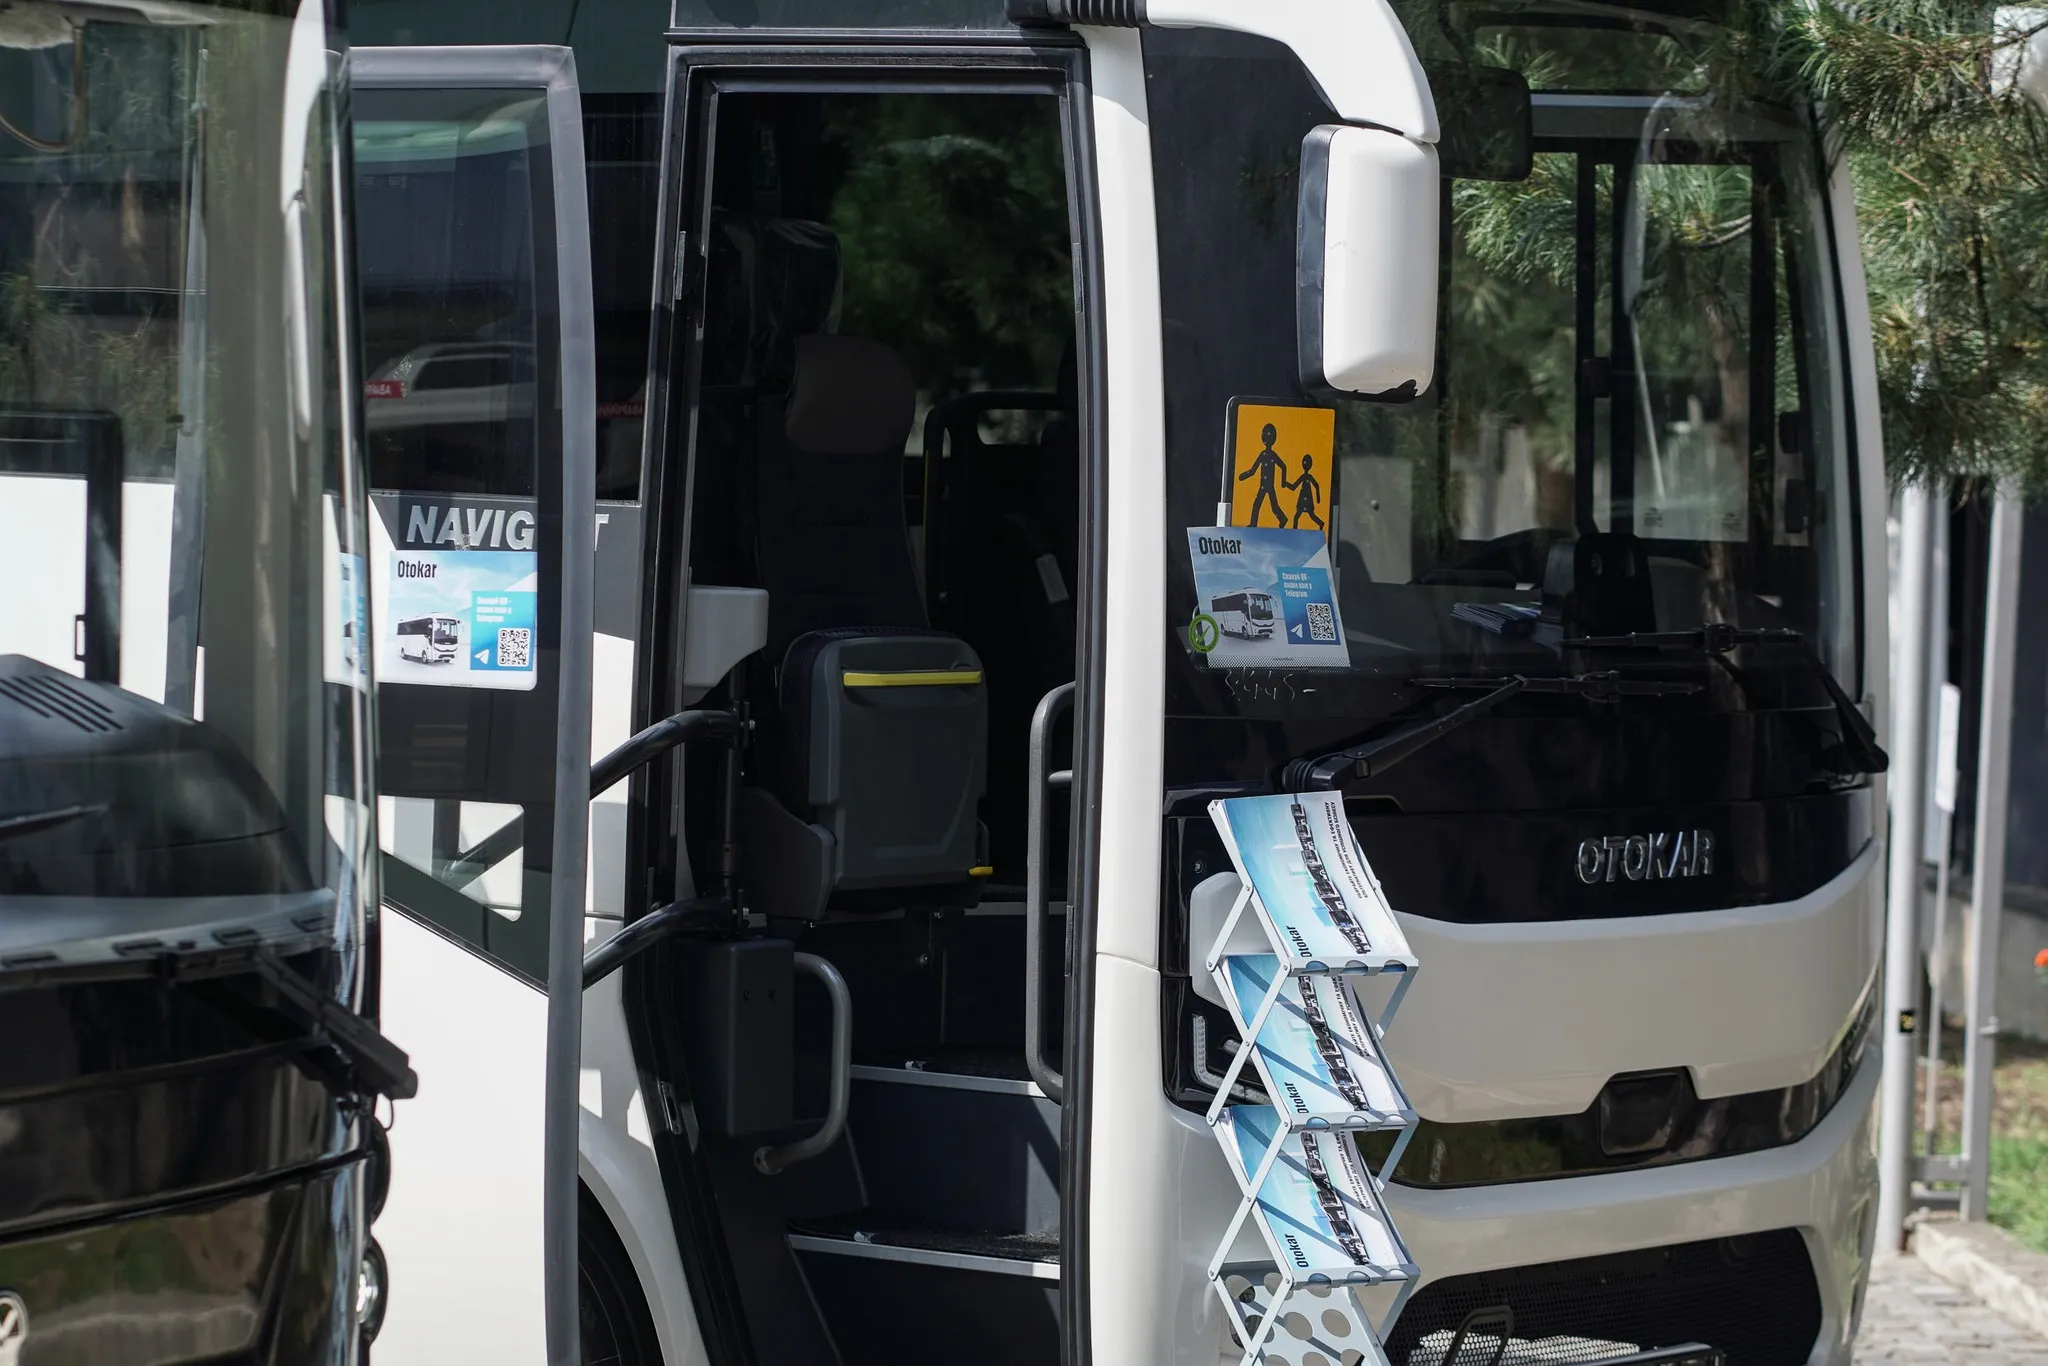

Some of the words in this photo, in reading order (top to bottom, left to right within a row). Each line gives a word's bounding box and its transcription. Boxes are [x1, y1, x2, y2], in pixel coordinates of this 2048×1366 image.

[406, 505, 536, 551] NAVIG
[1199, 536, 1242, 555] Otokar
[397, 560, 437, 579] Otokar
[1324, 801, 1336, 835] ЕФЕКТИВНУ
[1330, 801, 1339, 823] БІЗНЕСУ
[1344, 853, 1353, 865] ДЛЯ
[1575, 829, 1715, 884] OTOKAR
[1286, 925, 1312, 957] Otokar
[1347, 1011, 1356, 1023] ДЛЯ
[1284, 1081, 1309, 1114] Otokar
[1337, 1145, 1343, 1153] ТА
[1284, 1234, 1309, 1267] Otokar
